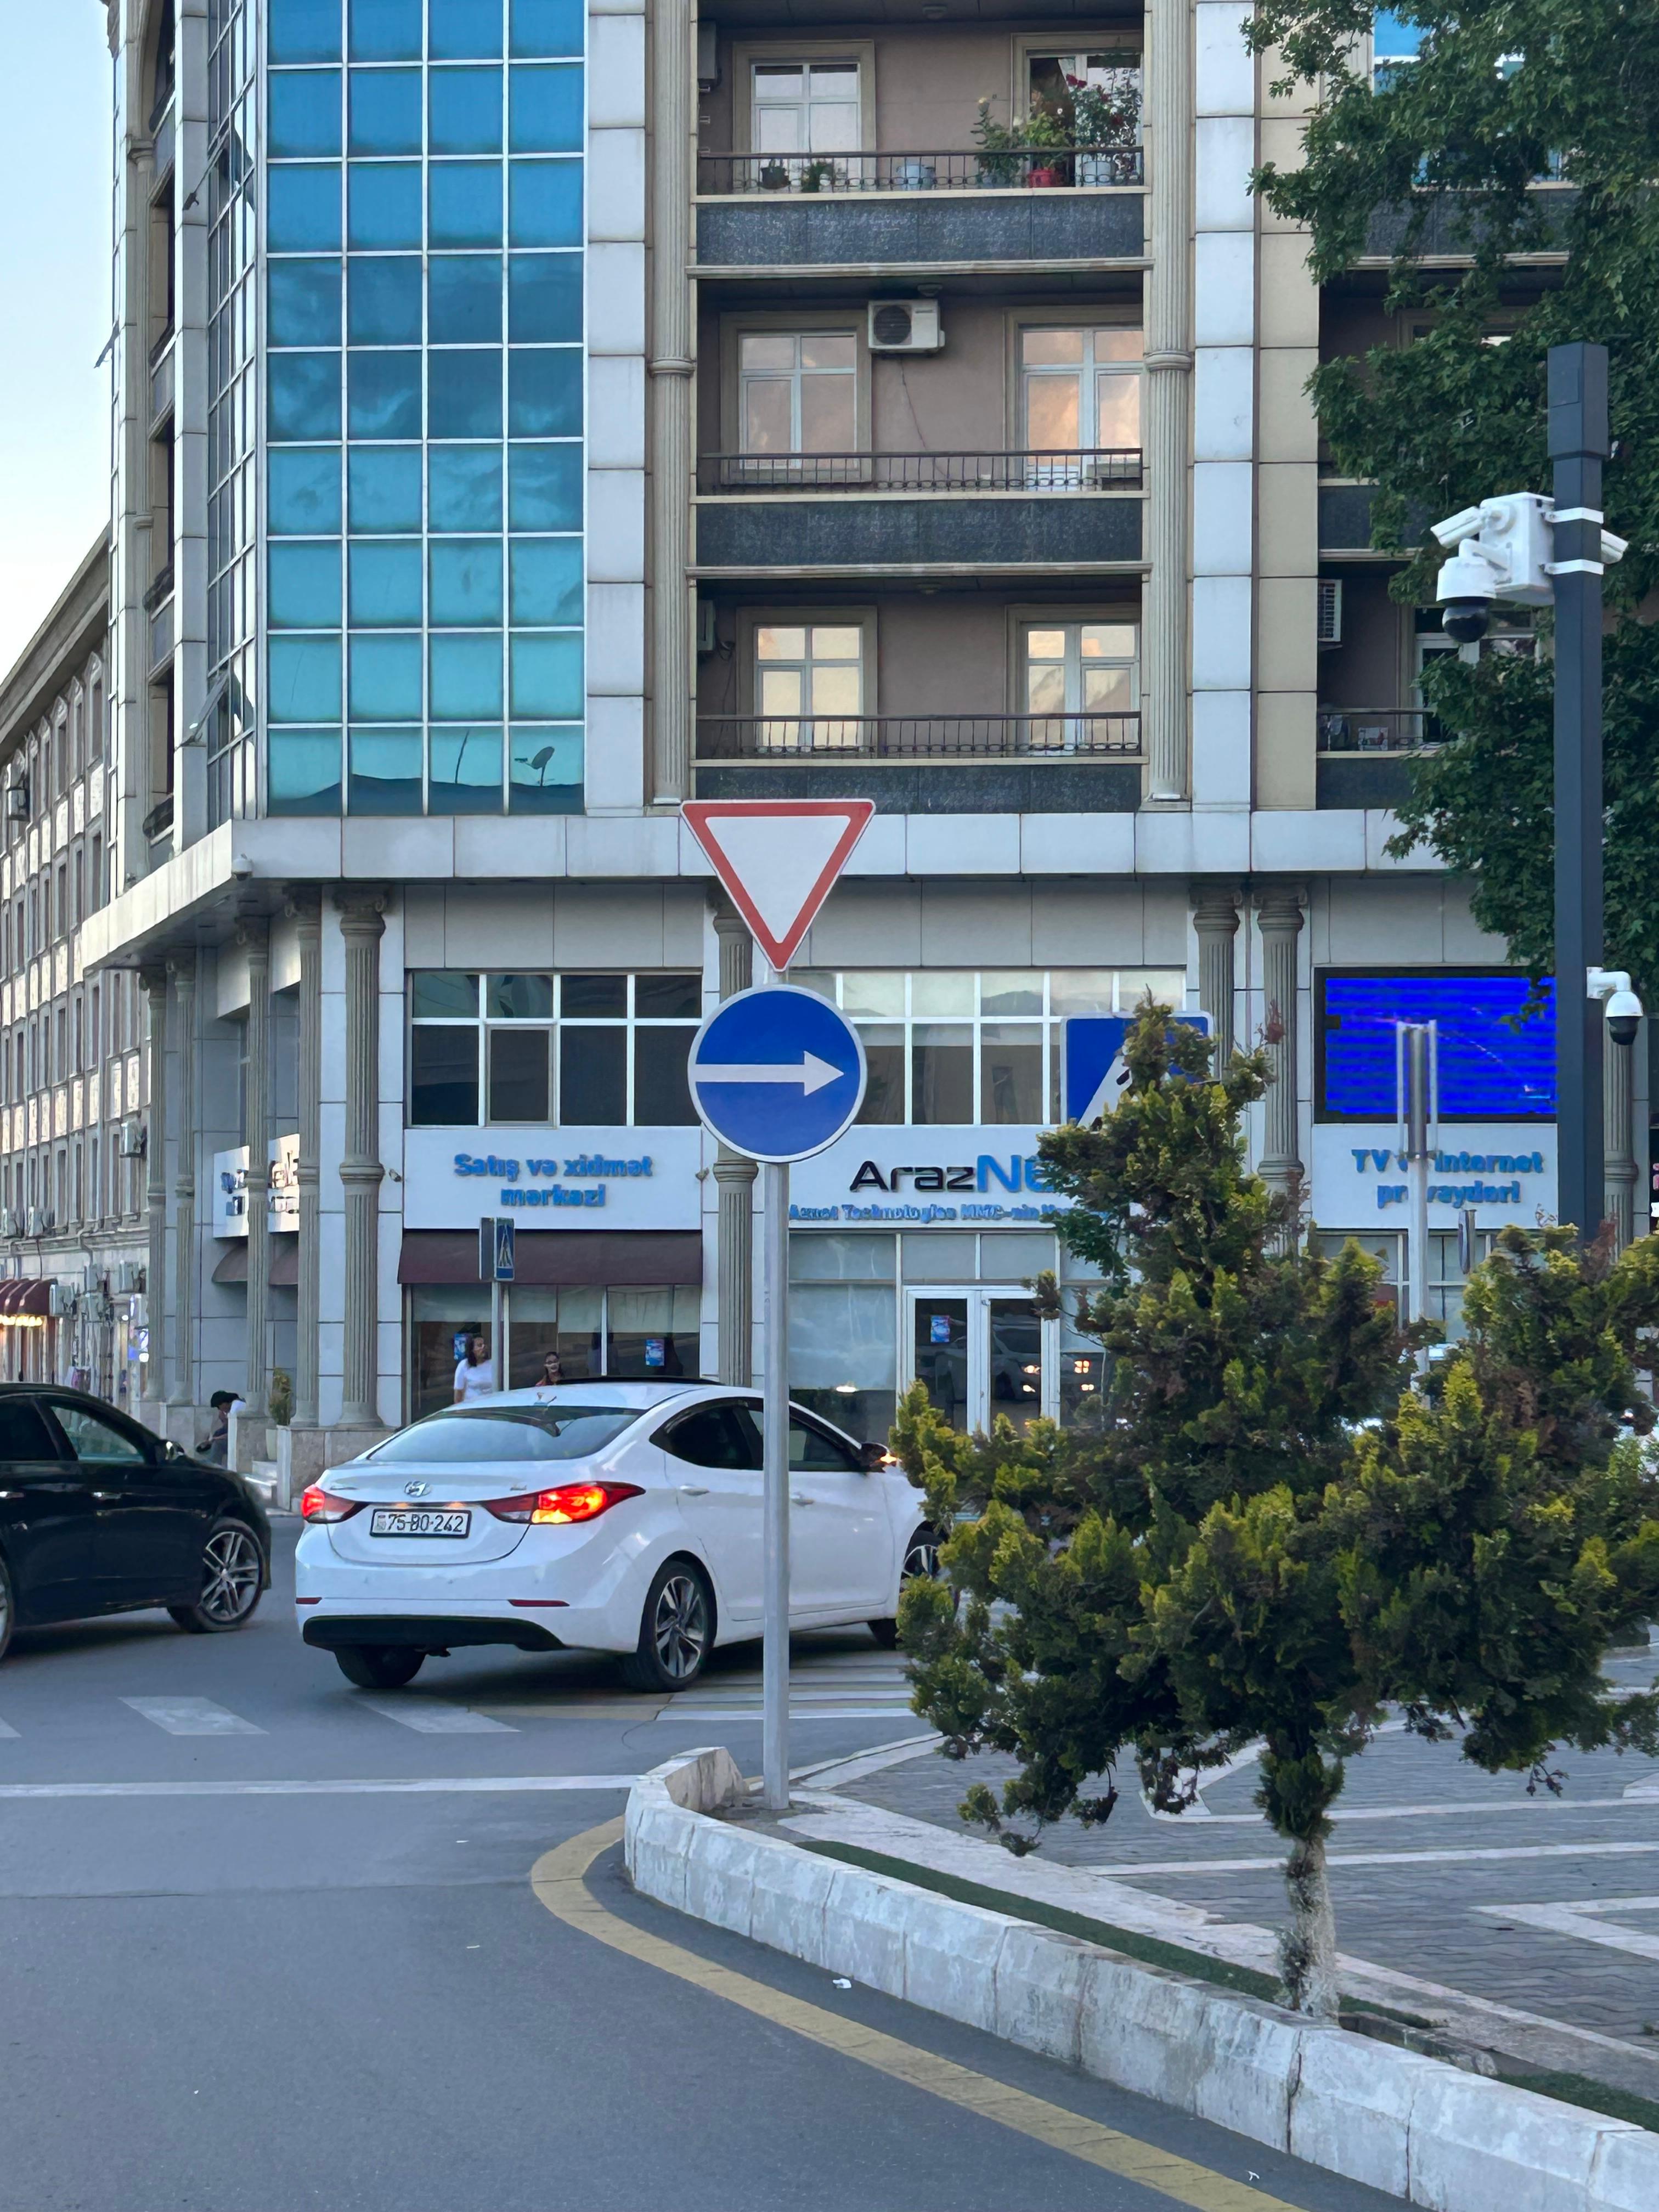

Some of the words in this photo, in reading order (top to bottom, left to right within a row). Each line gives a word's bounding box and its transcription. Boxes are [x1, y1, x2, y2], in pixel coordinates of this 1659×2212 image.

[454, 1153, 520, 1182] Satış
[526, 1159, 557, 1177] və
[563, 1154, 653, 1177] xidmət
[1351, 1149, 1391, 1172] TV
[501, 1183, 606, 1207] mərkəzi
[841, 1204, 957, 1223] Technologies
